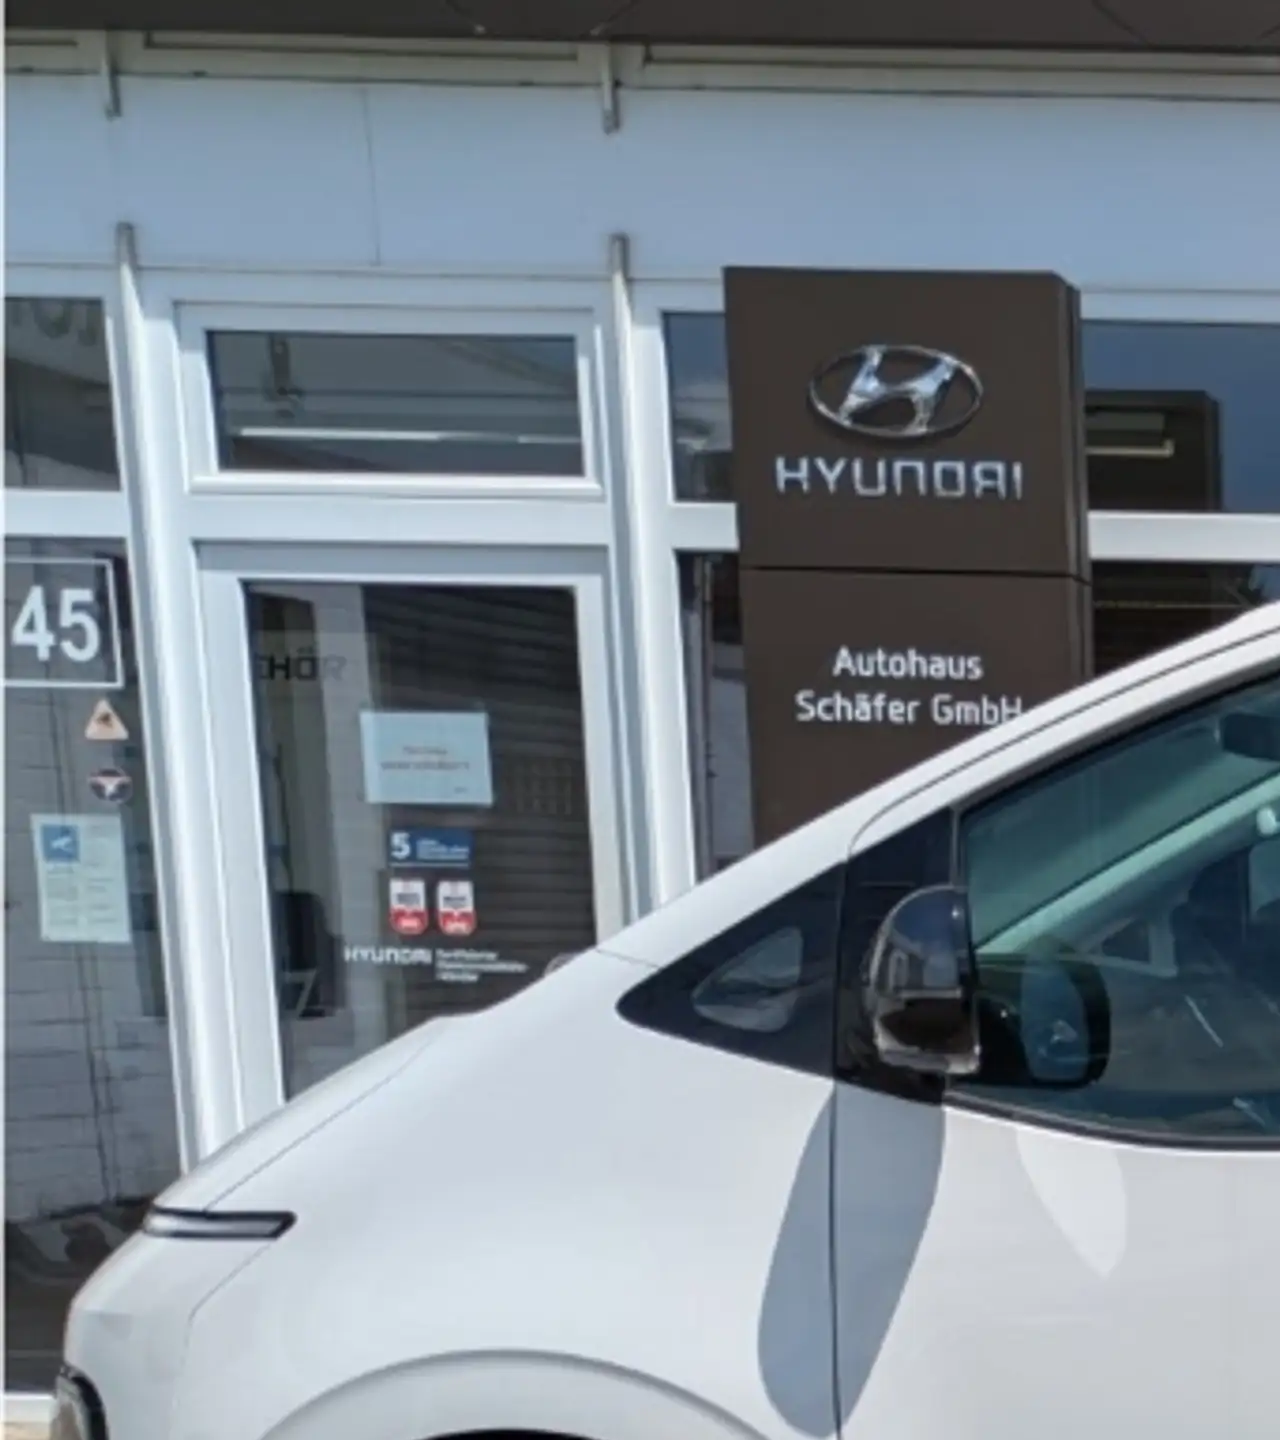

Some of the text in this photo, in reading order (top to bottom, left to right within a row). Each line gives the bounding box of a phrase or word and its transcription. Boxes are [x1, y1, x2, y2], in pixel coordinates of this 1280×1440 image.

[775, 456, 1024, 500] HYUNDAI
[12, 584, 99, 663] 45
[832, 645, 984, 682] Autohaus
[795, 688, 1023, 727] Schäfer GmbH
[391, 832, 412, 860] 5
